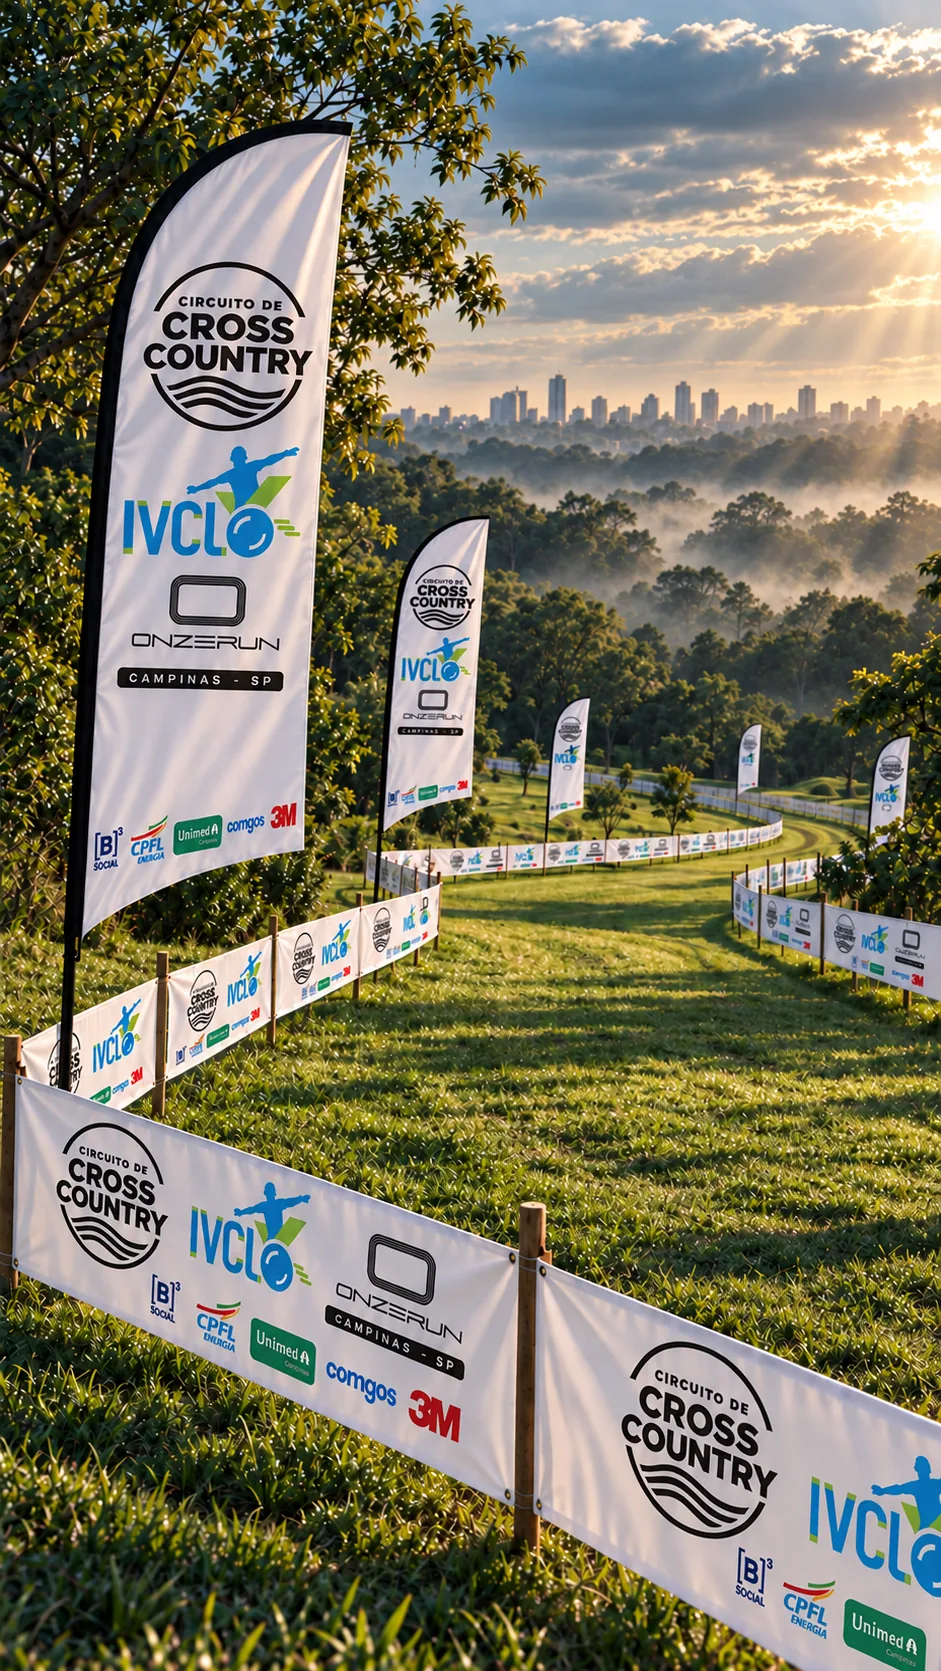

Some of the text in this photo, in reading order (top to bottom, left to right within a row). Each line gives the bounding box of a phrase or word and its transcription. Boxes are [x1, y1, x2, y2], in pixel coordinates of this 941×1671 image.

[178, 296, 282, 311] CIRCUITO DE
[162, 311, 294, 344] CROSS
[143, 343, 313, 376] COUNTRY
[410, 596, 475, 609] COUNTRY
[417, 585, 468, 597] CROSS
[131, 633, 280, 651] ONZERUN
[128, 673, 221, 685] CAMPINAS
[251, 676, 272, 686] SP
[402, 713, 463, 721] ONZERUN
[270, 802, 297, 829] 3M
[130, 837, 164, 857] CPFL
[178, 828, 210, 842] Unimed
[93, 858, 118, 871] SOCIAL
[190, 987, 215, 1005] CROSS
[79, 1146, 148, 1175] CIRCUITO DE
[68, 1158, 155, 1206] CROSS
[56, 1179, 169, 1237] COUNTRY
[150, 1305, 175, 1323] SOCIAL
[197, 1313, 236, 1342] CPFL
[336, 1282, 463, 1344] ONZERUN
[256, 1329, 299, 1360] Unimed
[335, 1314, 410, 1353] CAMPINAS
[436, 1356, 454, 1370] SP
[655, 1369, 749, 1415] CIRCUITO DE
[408, 1389, 462, 1443] 3M
[639, 1385, 759, 1456] CROSS
[621, 1413, 778, 1499] COUNTRY
[735, 1584, 765, 1607] SOCIAL
[783, 1593, 828, 1627] CPFL
[790, 1614, 828, 1639] ENERGIA
[852, 1612, 904, 1650] Unimed
